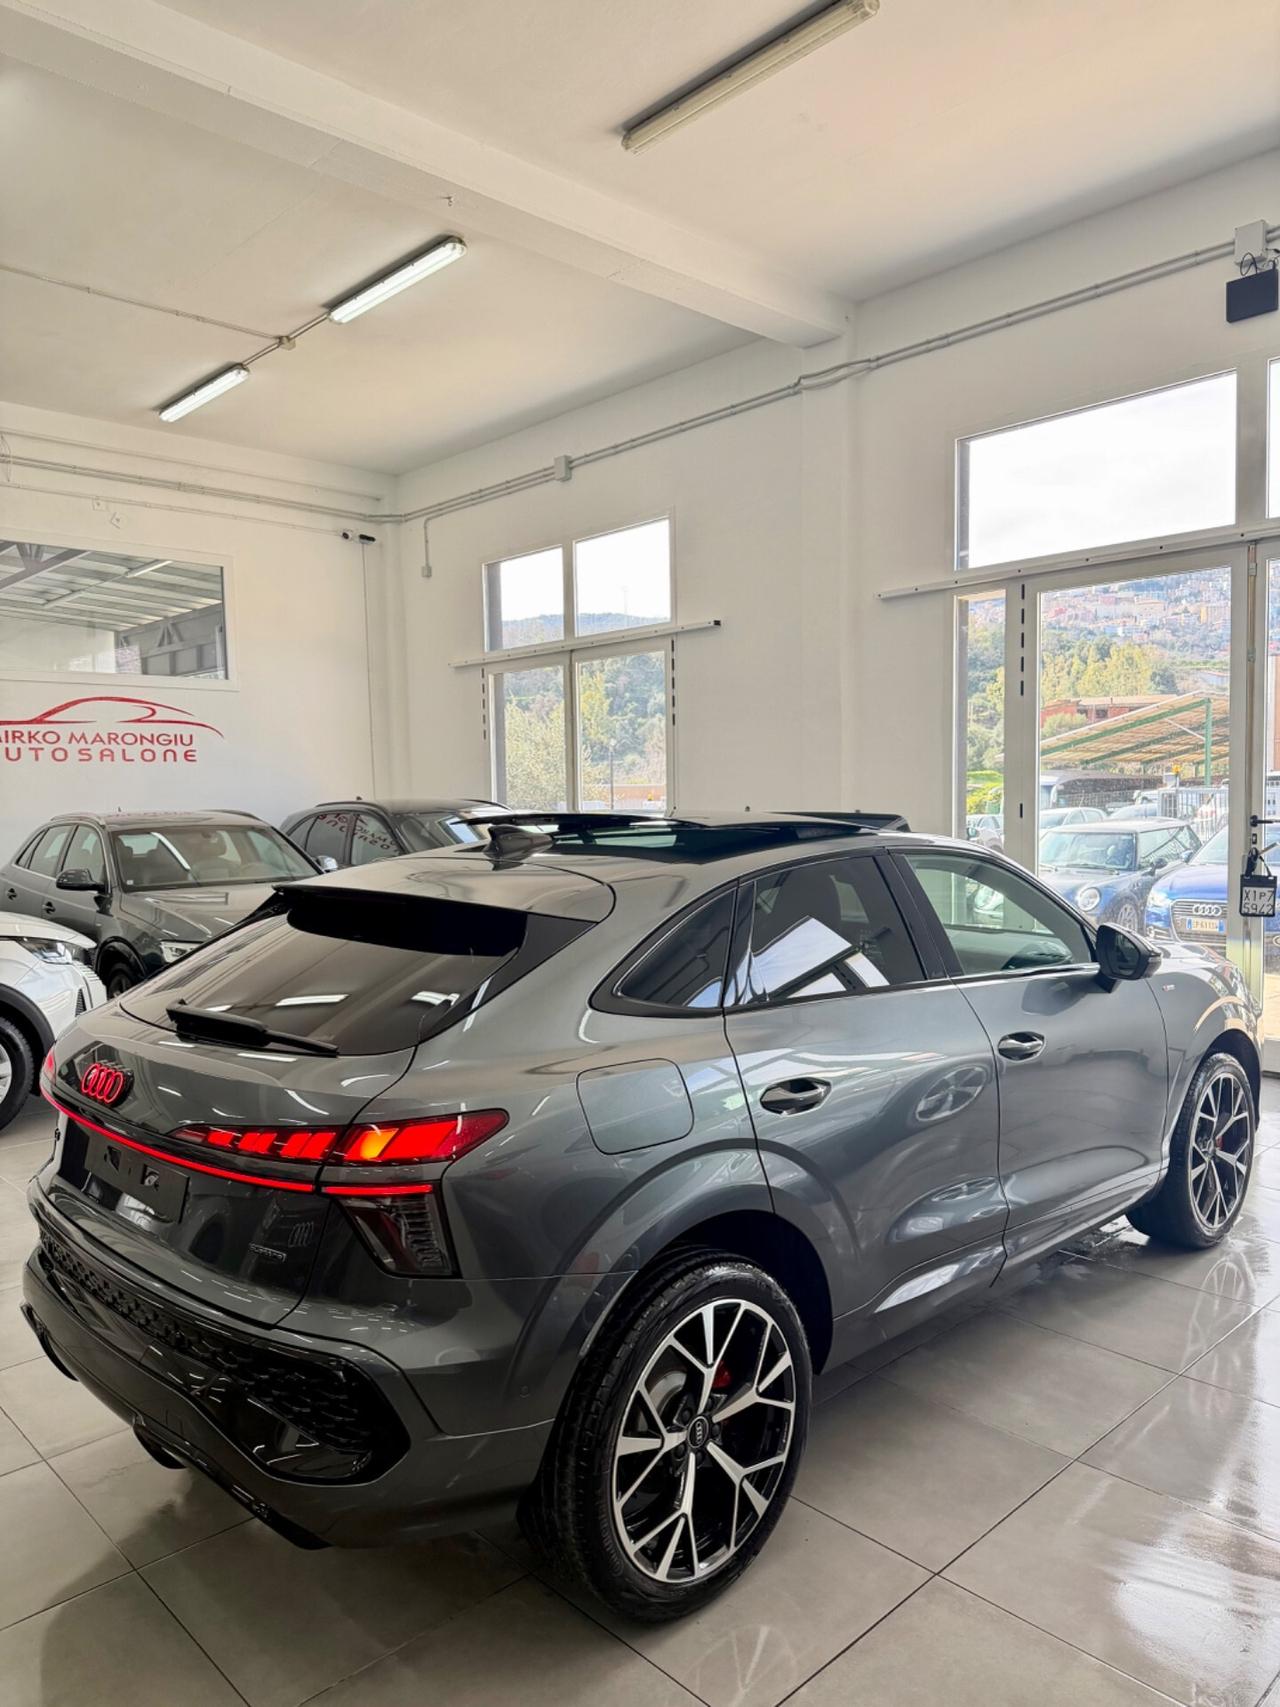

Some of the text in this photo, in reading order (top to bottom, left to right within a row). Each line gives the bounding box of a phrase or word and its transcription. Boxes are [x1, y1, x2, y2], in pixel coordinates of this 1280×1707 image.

[0, 730, 193, 746] IRKO MARONGIU
[5, 747, 197, 762] UTOSALONE
